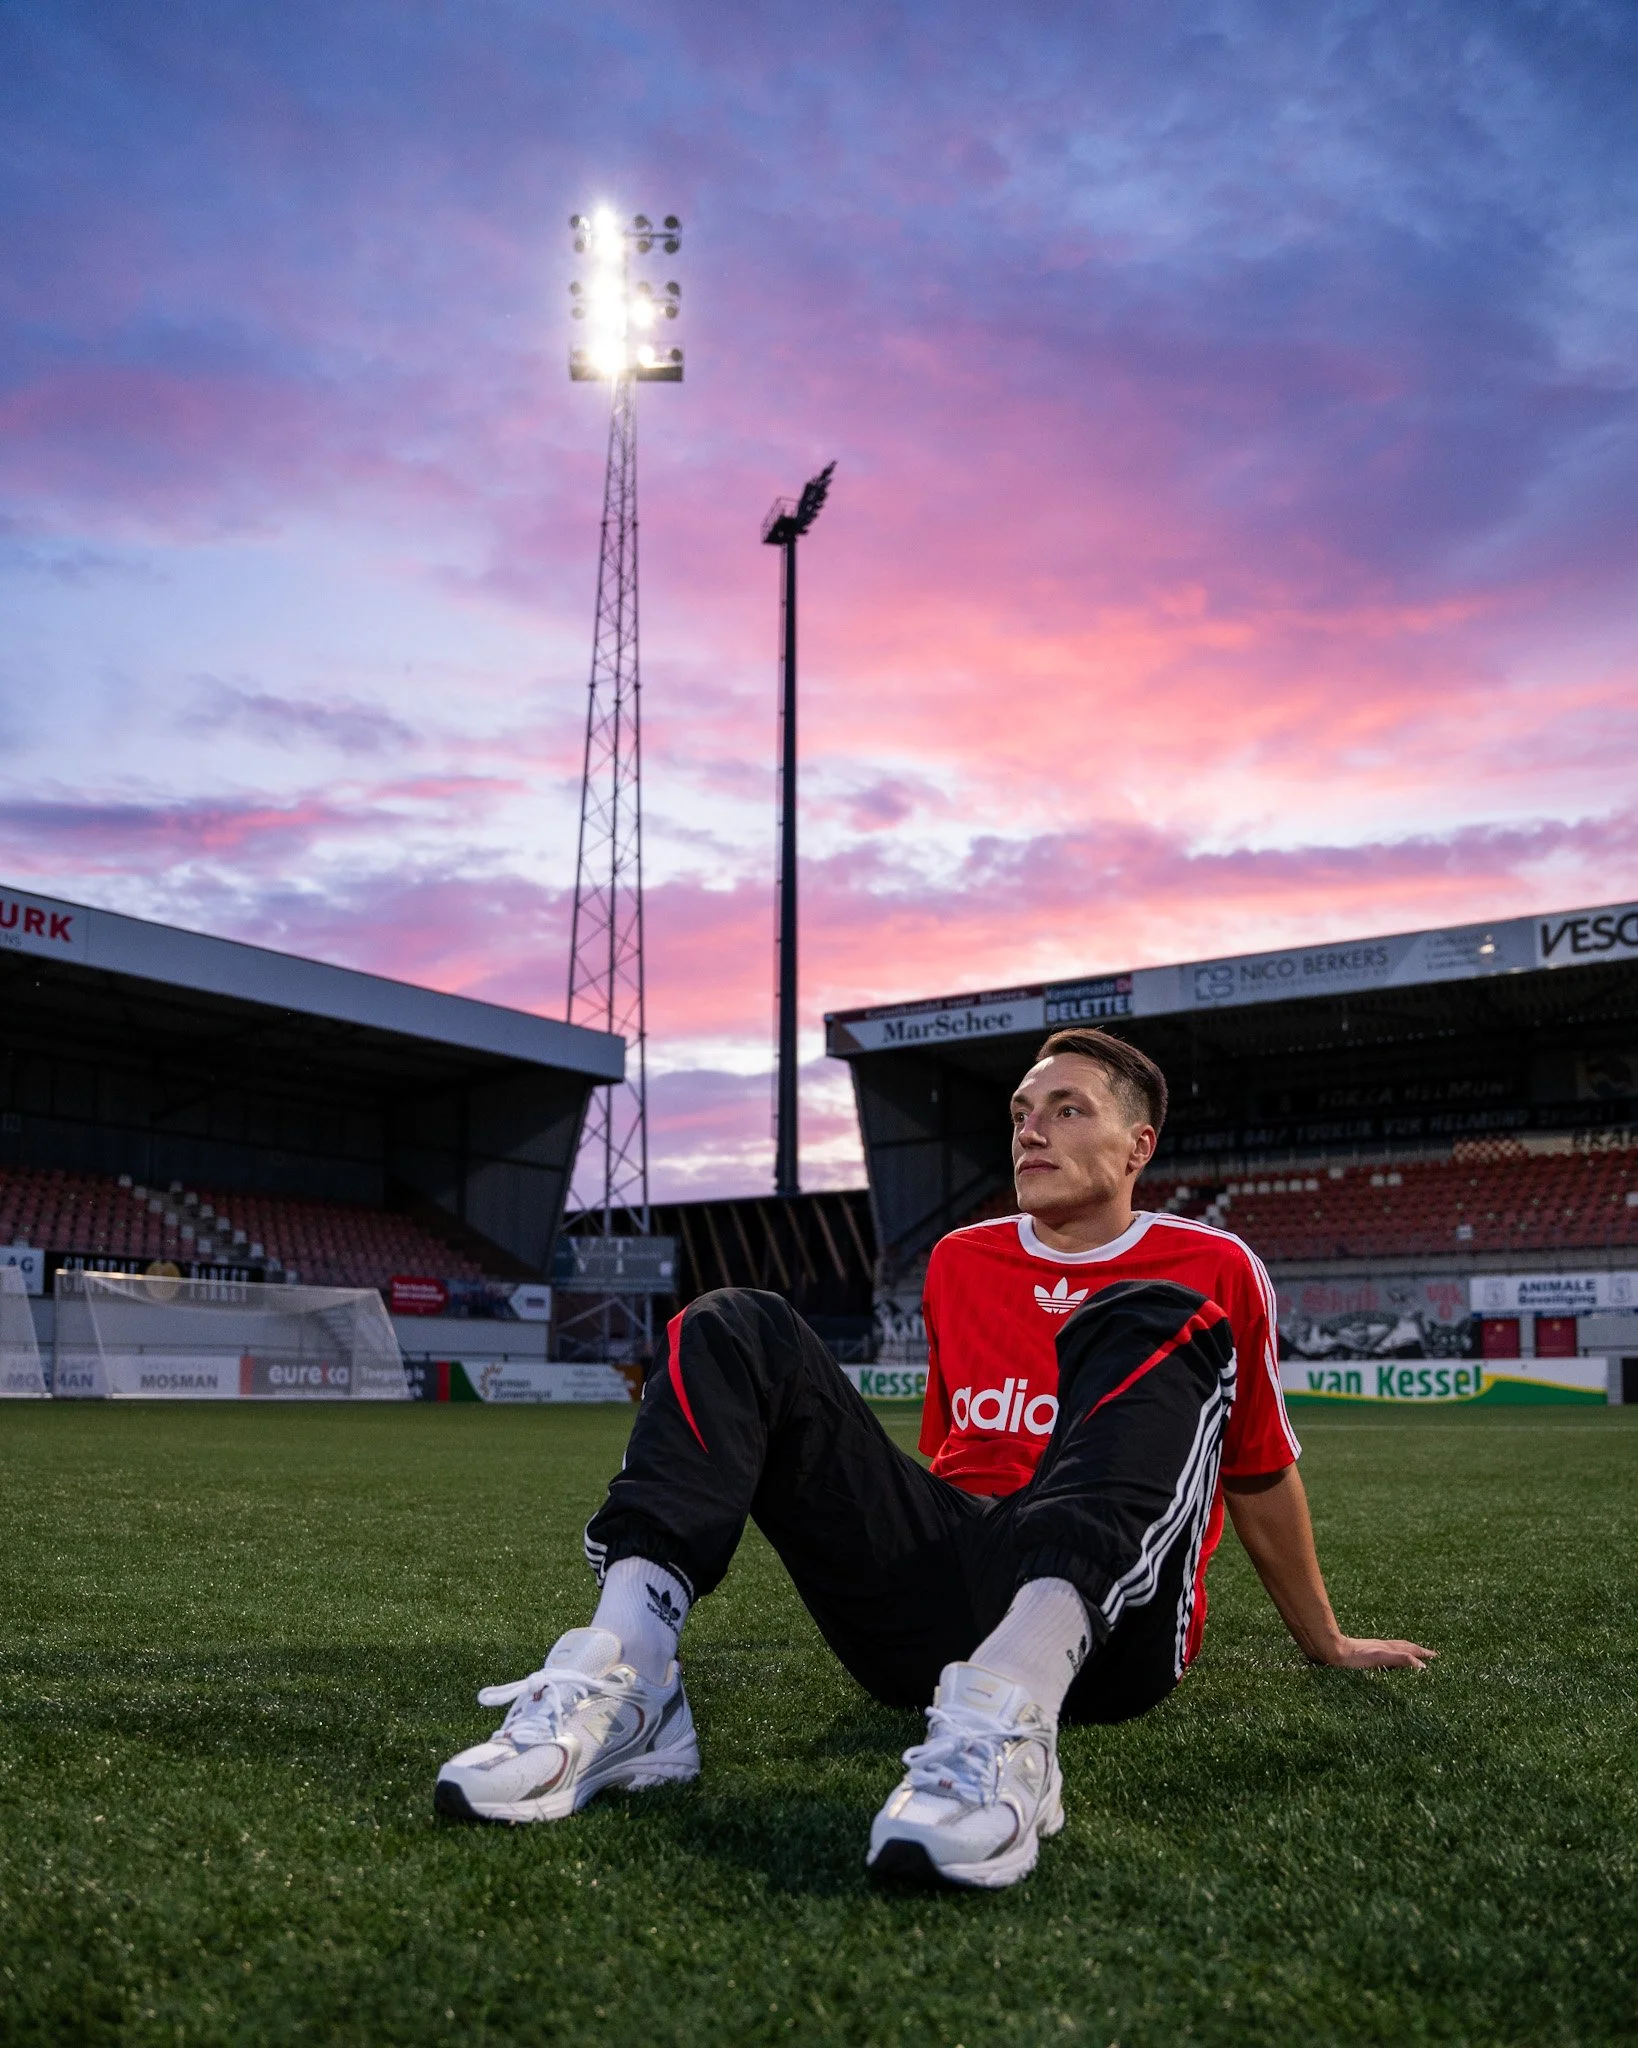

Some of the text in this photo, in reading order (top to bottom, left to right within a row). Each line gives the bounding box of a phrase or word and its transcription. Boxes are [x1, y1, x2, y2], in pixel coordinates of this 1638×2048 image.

[1240, 958, 1297, 982] NICO
[1302, 946, 1389, 976] BERKERS
[881, 1010, 1013, 1043] MarSchee
[1518, 1278, 1596, 1292] ANIMALE
[140, 1373, 218, 1390] MOSMAN
[859, 1367, 926, 1396] Kesse
[1307, 1365, 1483, 1397] van Kessel
